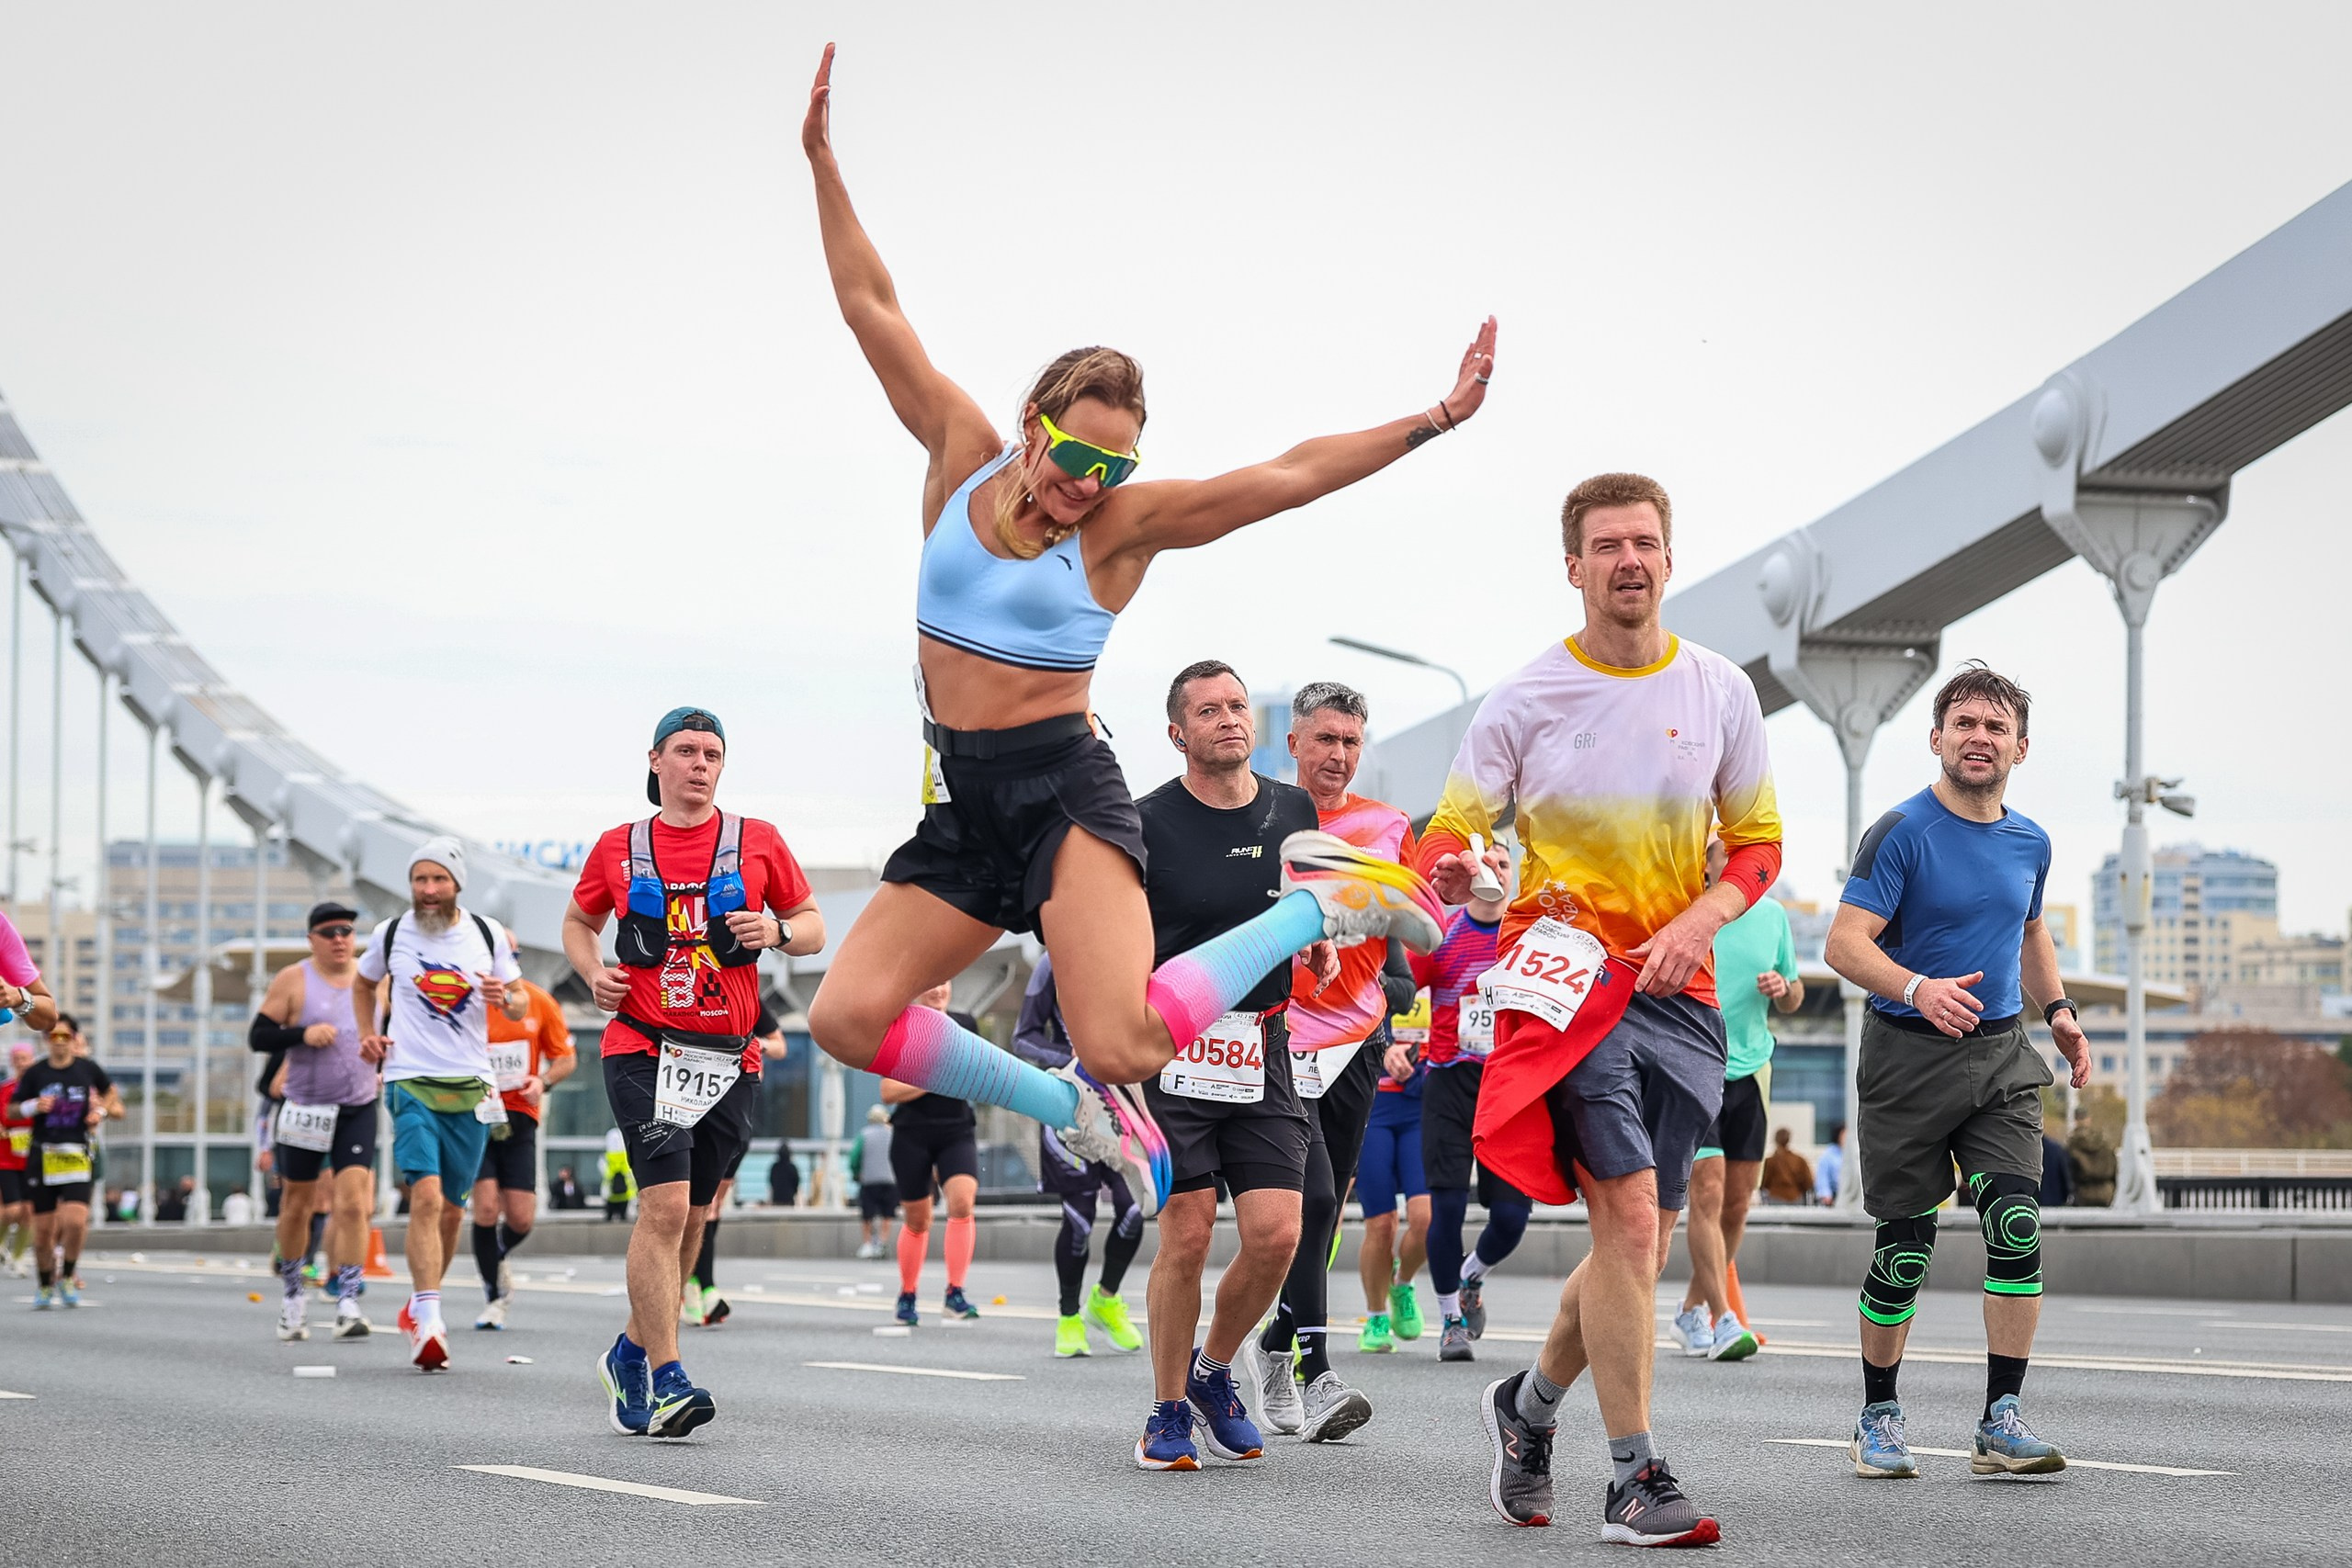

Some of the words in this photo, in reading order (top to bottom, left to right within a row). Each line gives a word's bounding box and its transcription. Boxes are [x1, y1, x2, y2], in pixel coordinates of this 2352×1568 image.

[1505, 943, 1589, 995] 1524
[1469, 1010, 1492, 1028] 95
[1171, 1036, 1262, 1071] 0584
[1173, 1074, 1186, 1090] F
